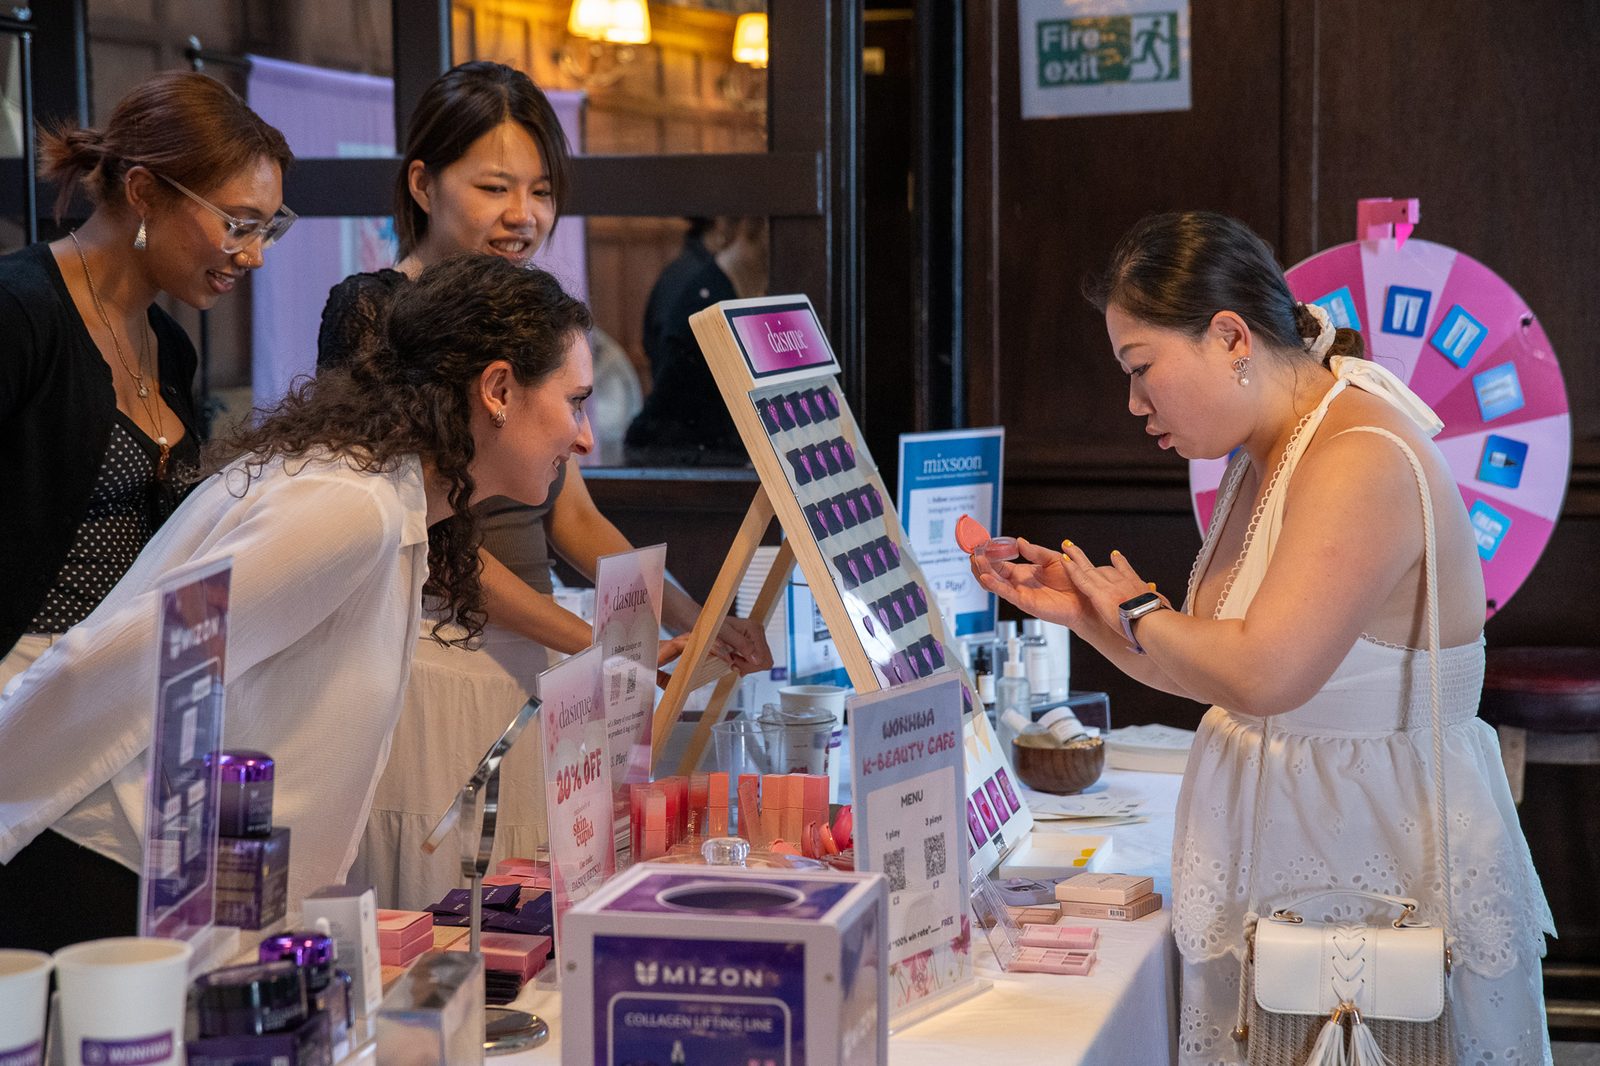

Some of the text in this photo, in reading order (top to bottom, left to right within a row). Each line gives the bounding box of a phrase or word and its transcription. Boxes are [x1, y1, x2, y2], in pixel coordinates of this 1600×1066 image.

[1042, 25, 1100, 51] Fire
[1044, 54, 1099, 82] exit
[765, 320, 809, 358] dasique
[923, 453, 982, 475] mixsoon
[612, 583, 648, 613] dasique
[558, 694, 592, 729] dasique
[882, 708, 935, 740] WONHWA
[583, 748, 602, 785] OFF
[862, 740, 925, 776] K-BEAUTY
[900, 789, 924, 808] MENU
[889, 830, 901, 840] play
[662, 965, 765, 989] MIZON
[624, 1011, 774, 1033] COLLAGEN LIFTING LINE
